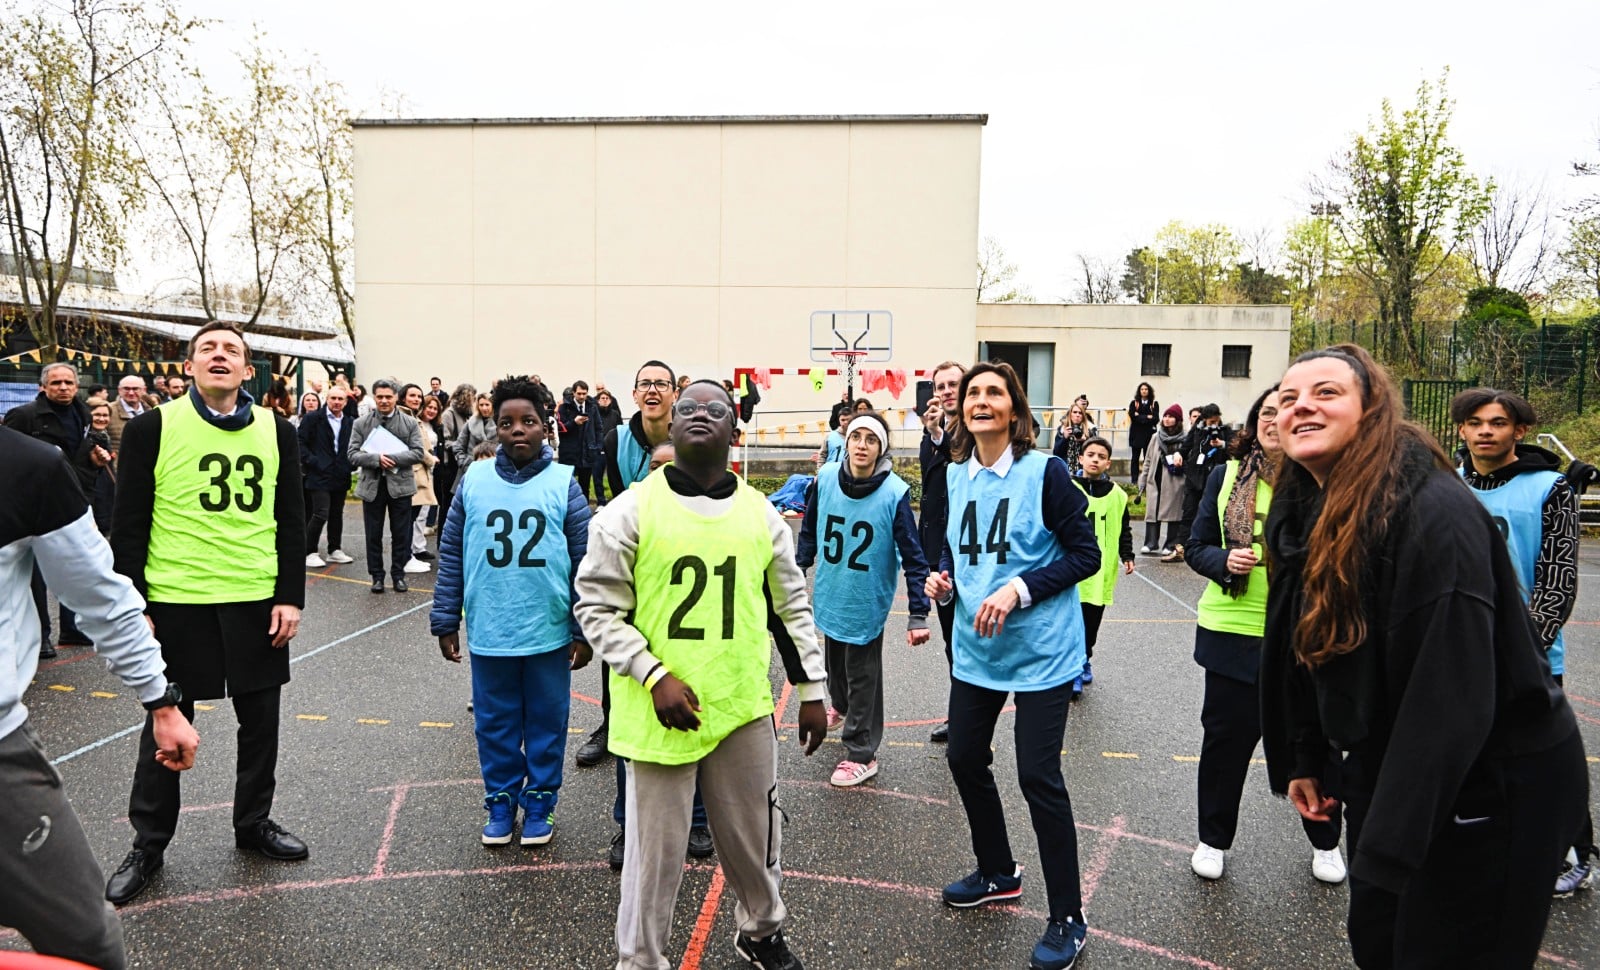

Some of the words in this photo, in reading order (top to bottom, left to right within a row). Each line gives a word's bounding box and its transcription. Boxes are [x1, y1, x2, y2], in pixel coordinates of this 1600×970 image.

[199, 453, 264, 513] 33
[486, 509, 546, 568] 32
[824, 514, 875, 572] 52
[959, 498, 1011, 566] 44
[668, 555, 736, 640] 21
